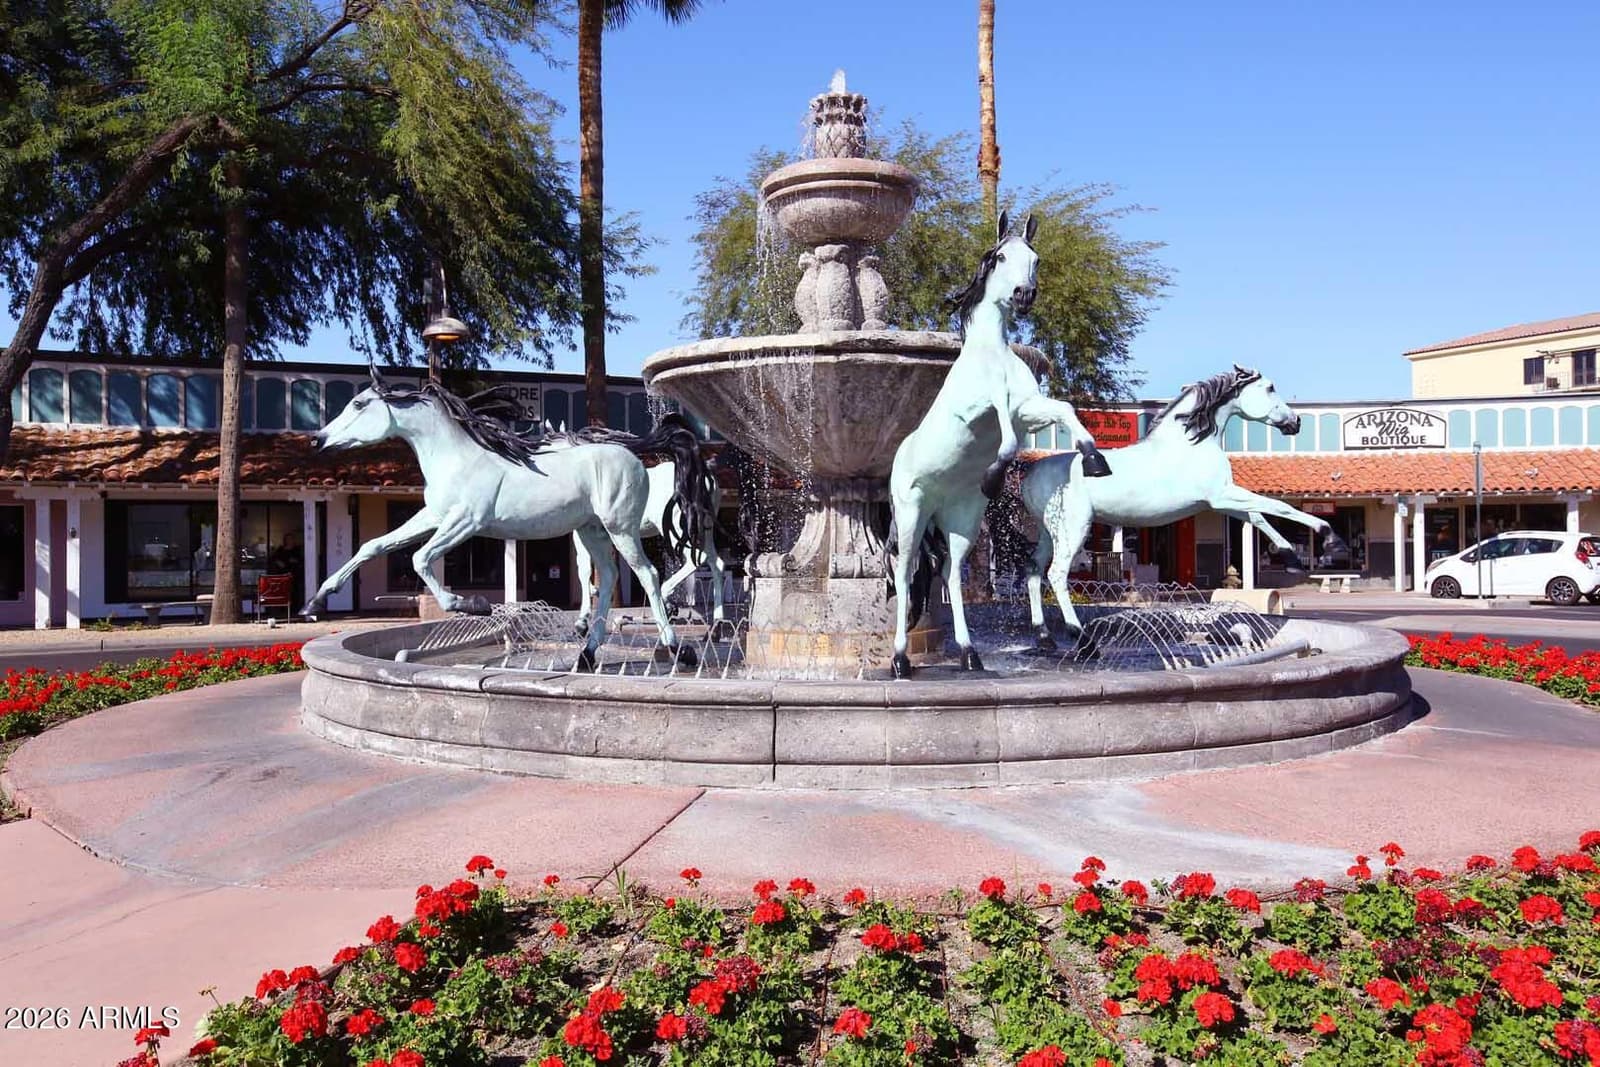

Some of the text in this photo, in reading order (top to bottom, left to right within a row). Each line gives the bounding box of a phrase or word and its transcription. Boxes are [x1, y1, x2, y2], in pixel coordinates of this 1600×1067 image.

[1355, 411, 1434, 429] ARIZONA
[1376, 420, 1410, 437] Wig
[1361, 435, 1427, 446] BOUTIQUE
